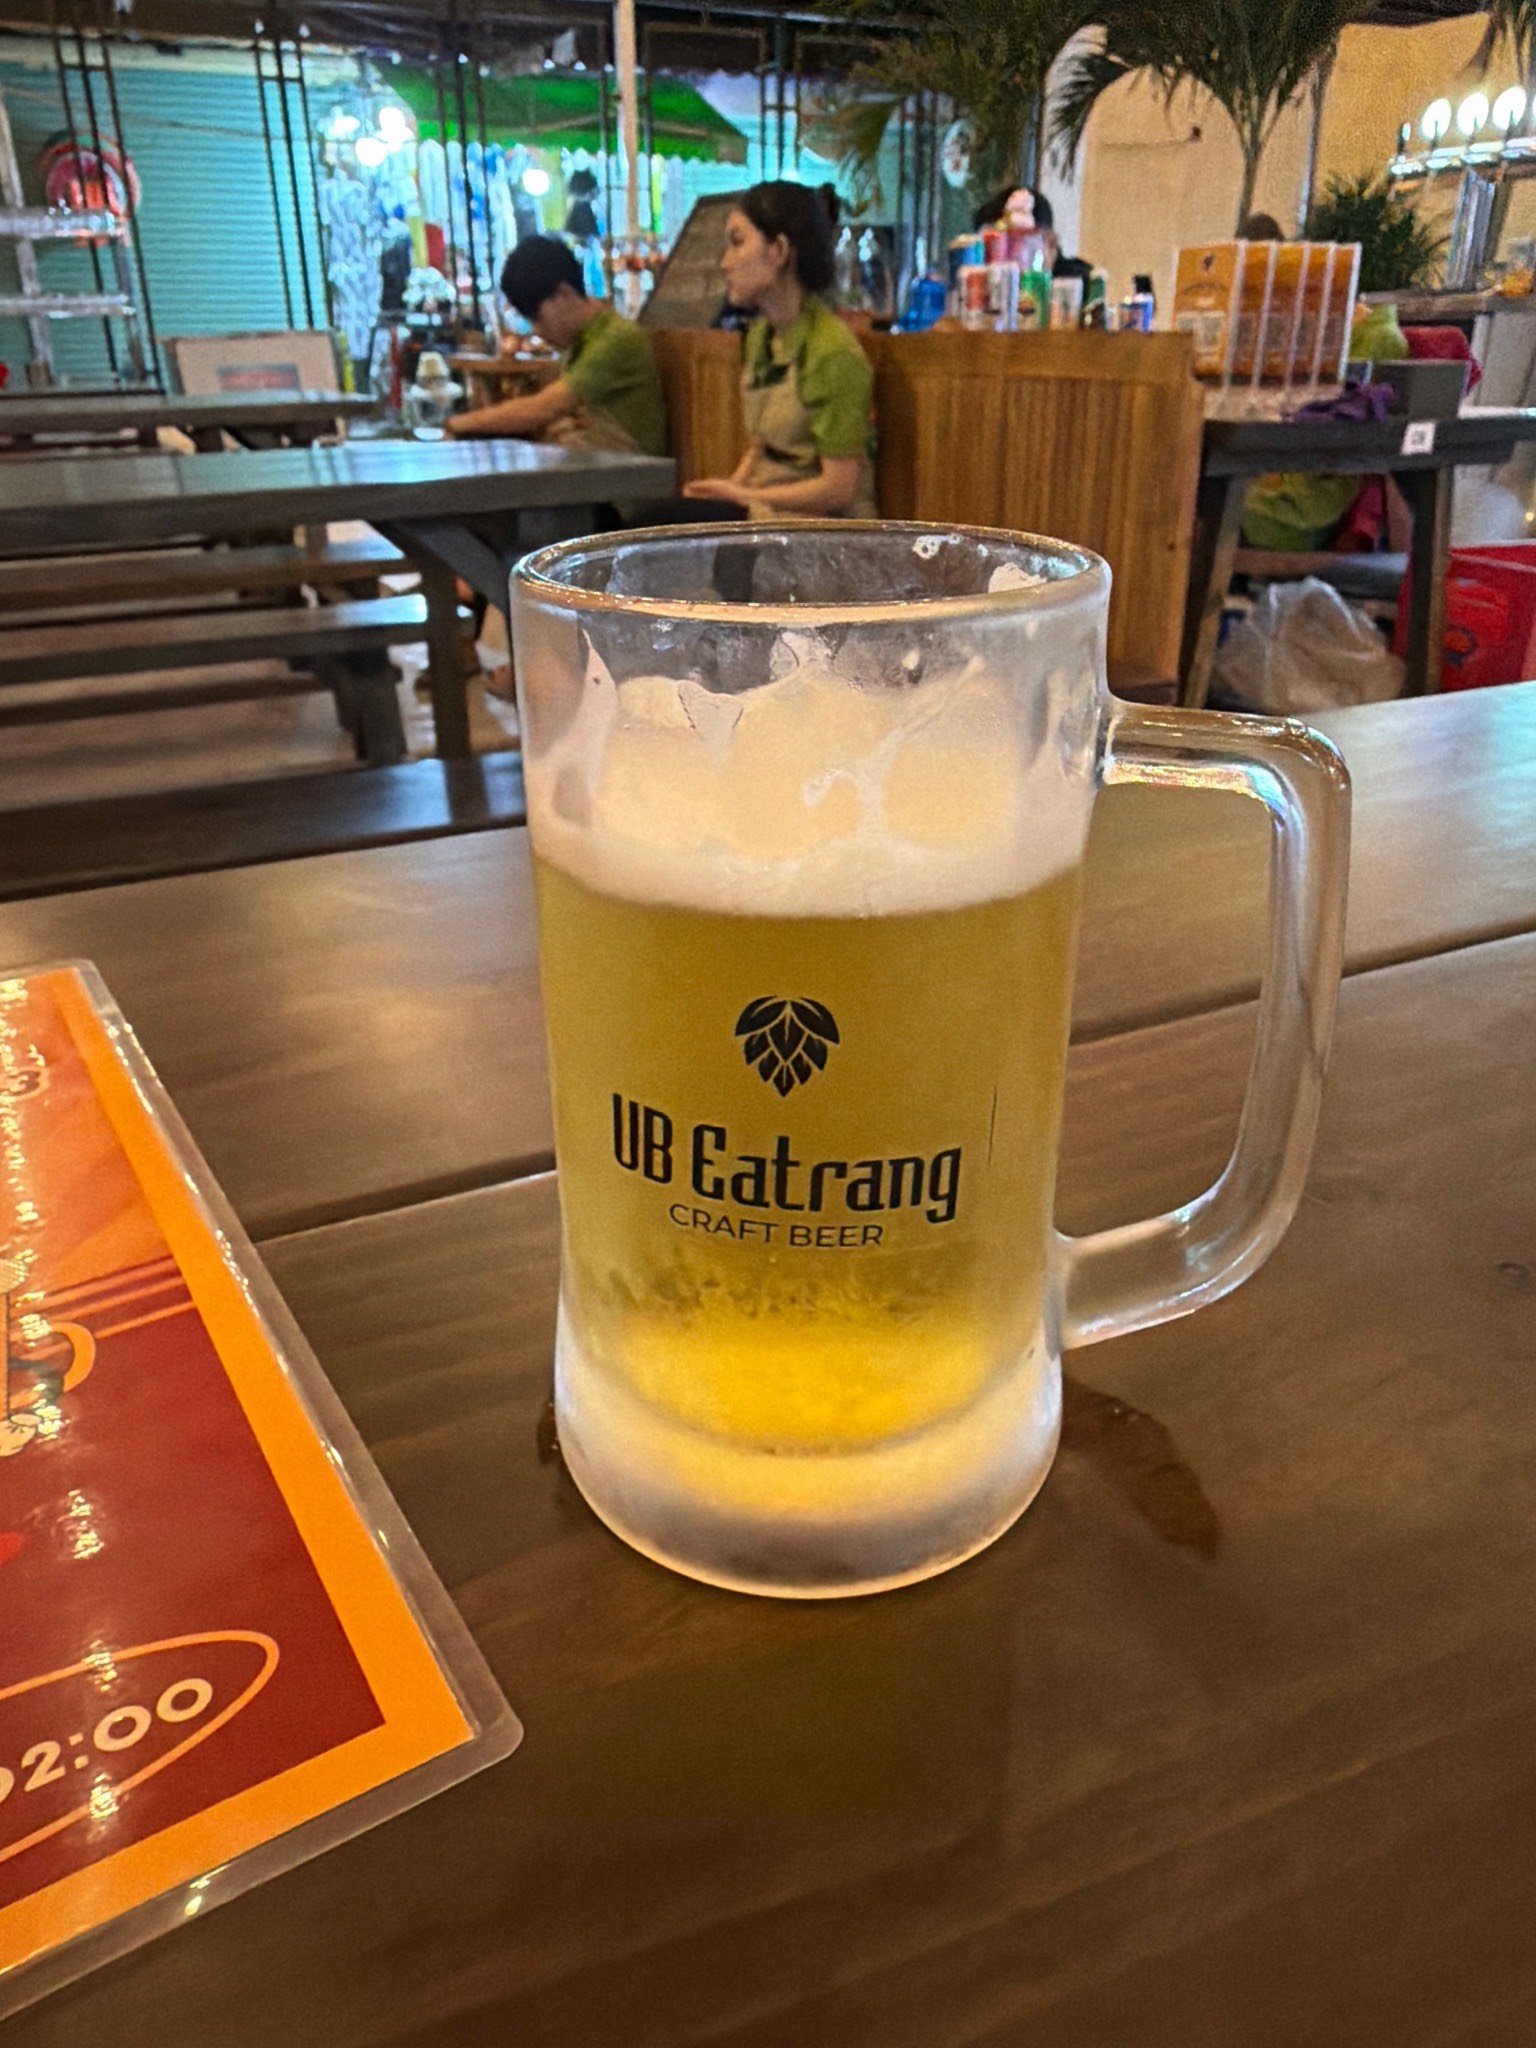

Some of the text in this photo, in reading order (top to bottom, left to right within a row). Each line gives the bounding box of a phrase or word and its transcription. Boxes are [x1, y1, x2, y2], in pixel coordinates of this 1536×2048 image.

[611, 1092, 962, 1225] UB Eatrang
[668, 1203, 884, 1248] CRAFT BEER
[0, 1677, 213, 1801] 2:00
